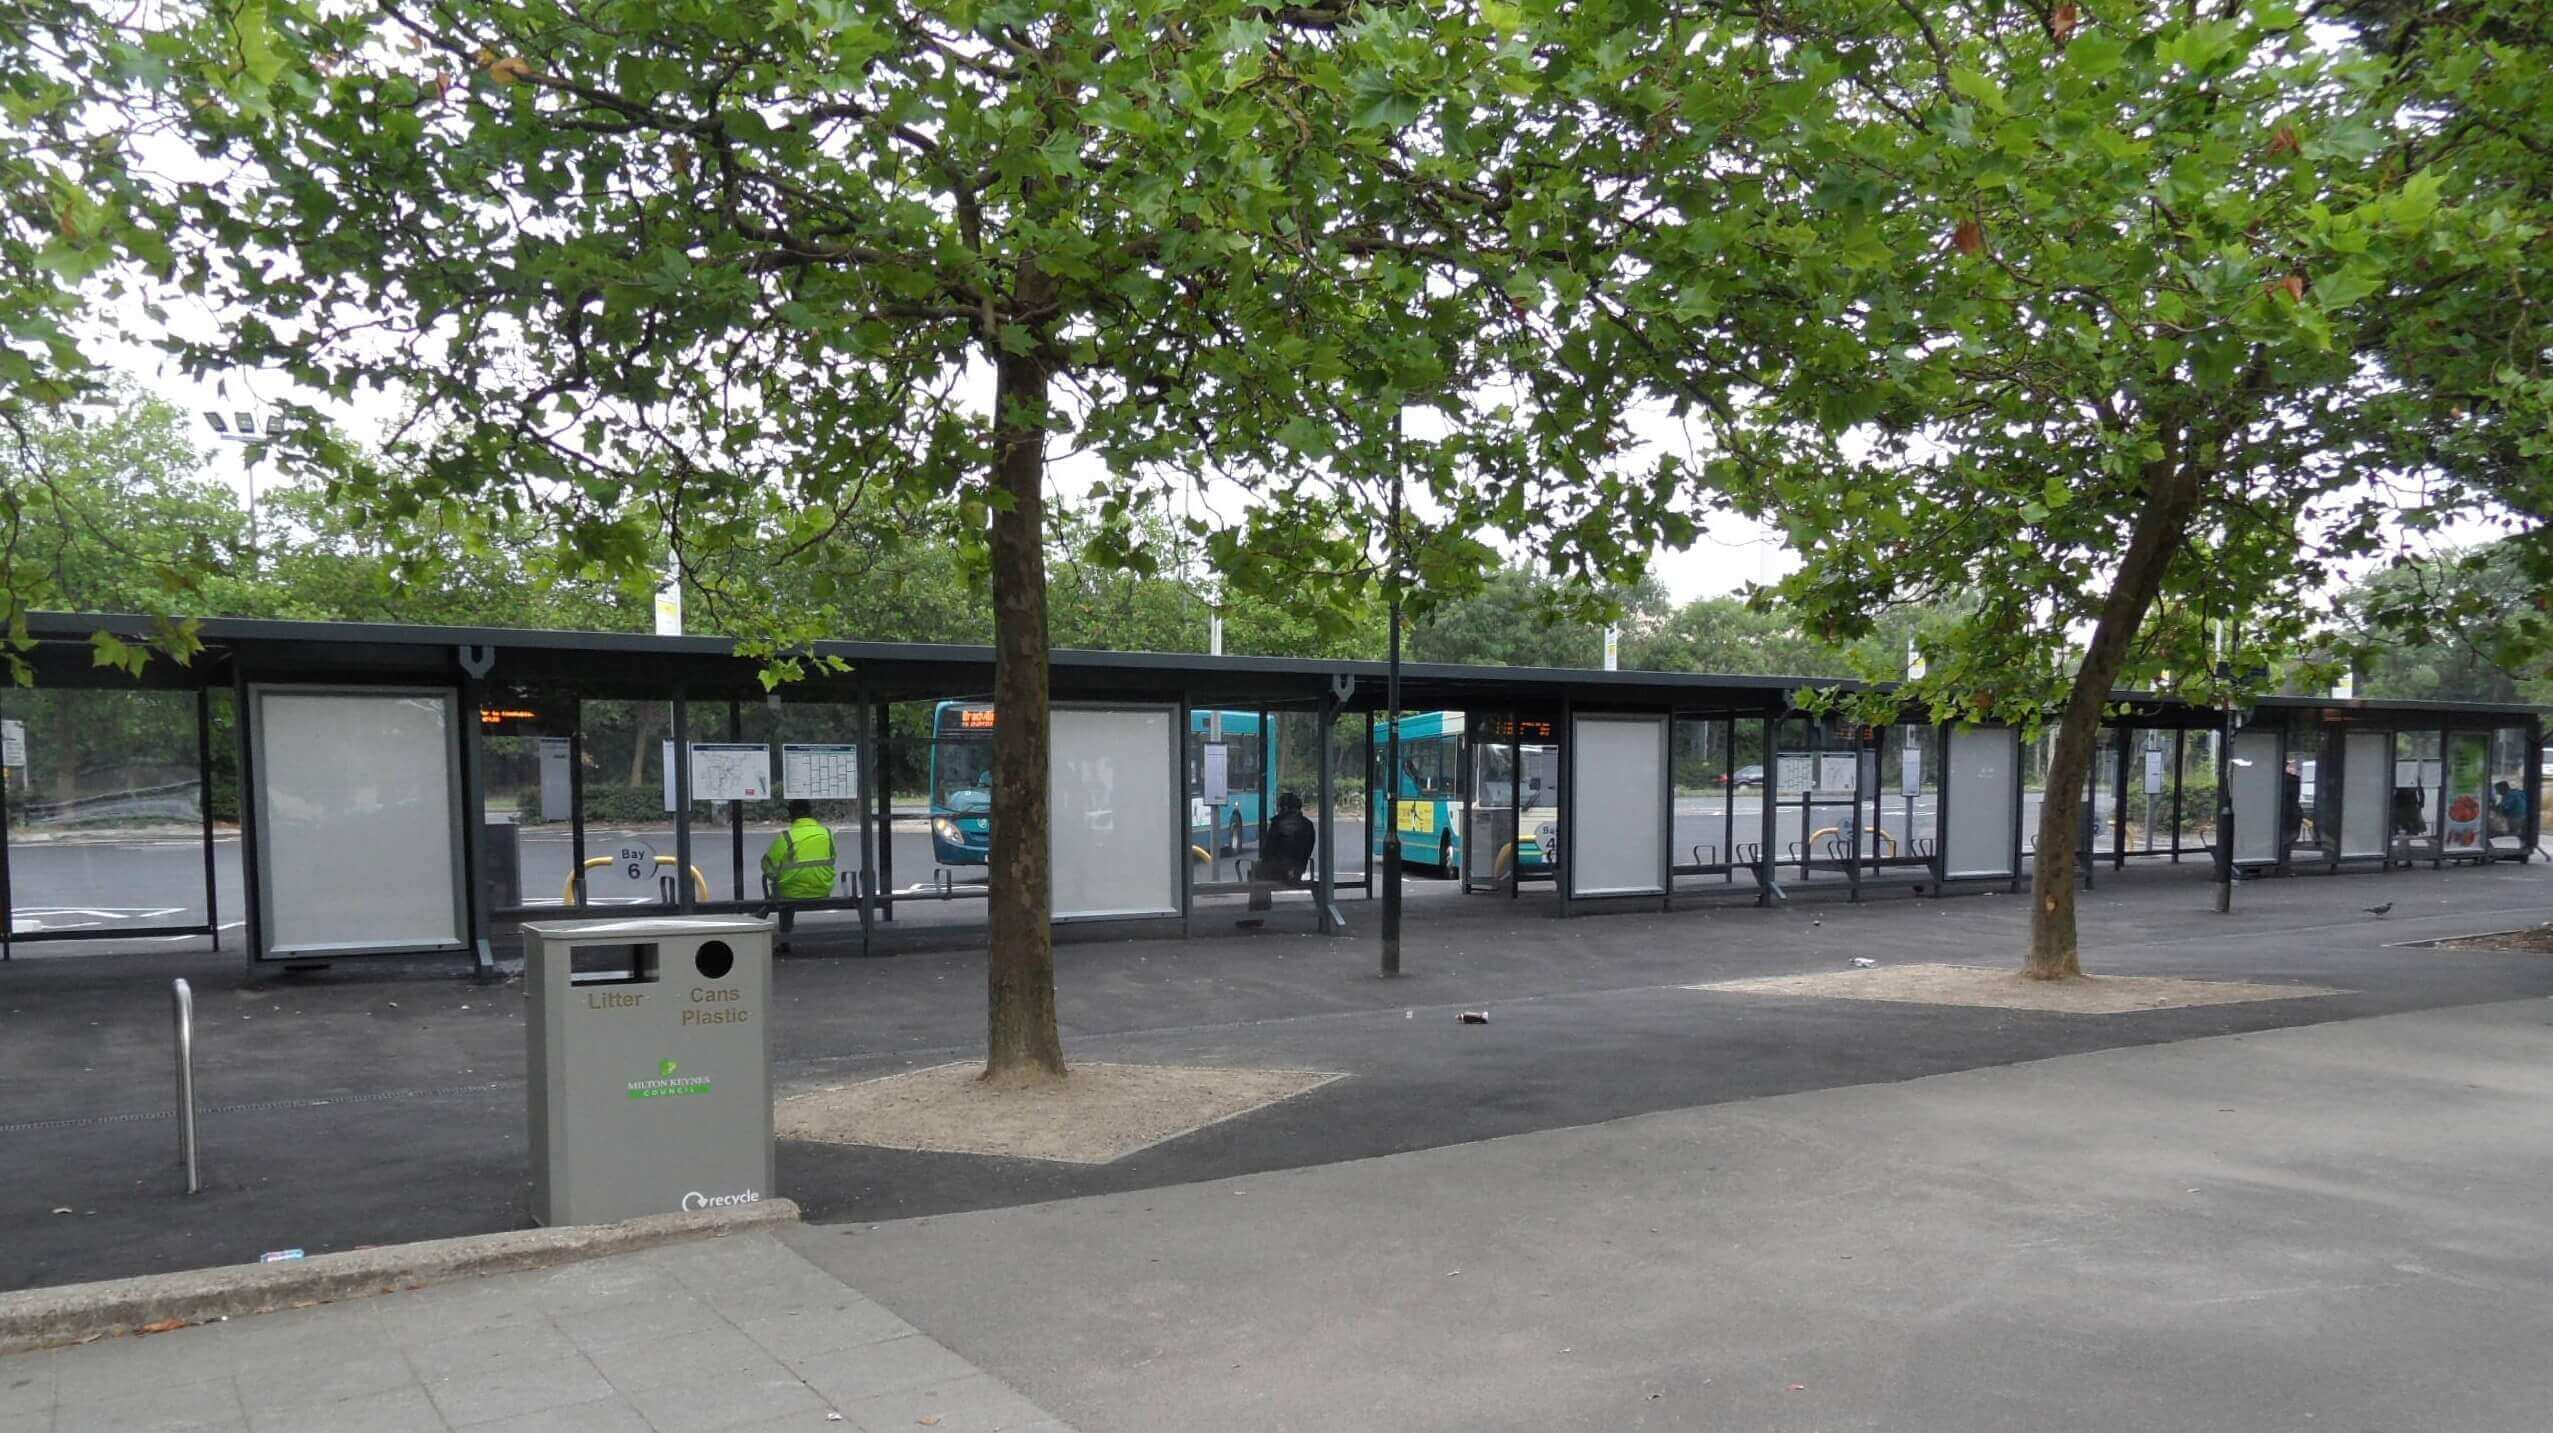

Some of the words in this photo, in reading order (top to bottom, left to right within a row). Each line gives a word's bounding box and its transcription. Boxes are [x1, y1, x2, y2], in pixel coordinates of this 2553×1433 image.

[1543, 826, 1556, 835] Ba
[621, 848, 646, 861] Bay
[628, 863, 641, 880] 6
[588, 992, 644, 1010] Litter
[690, 987, 741, 1003] Cans
[681, 1008, 749, 1026] Plastic
[627, 1079, 668, 1090] MILTON
[670, 1075, 711, 1087] KEYNES
[643, 1087, 695, 1097] COUNCIL
[709, 1188, 760, 1207] recycle
